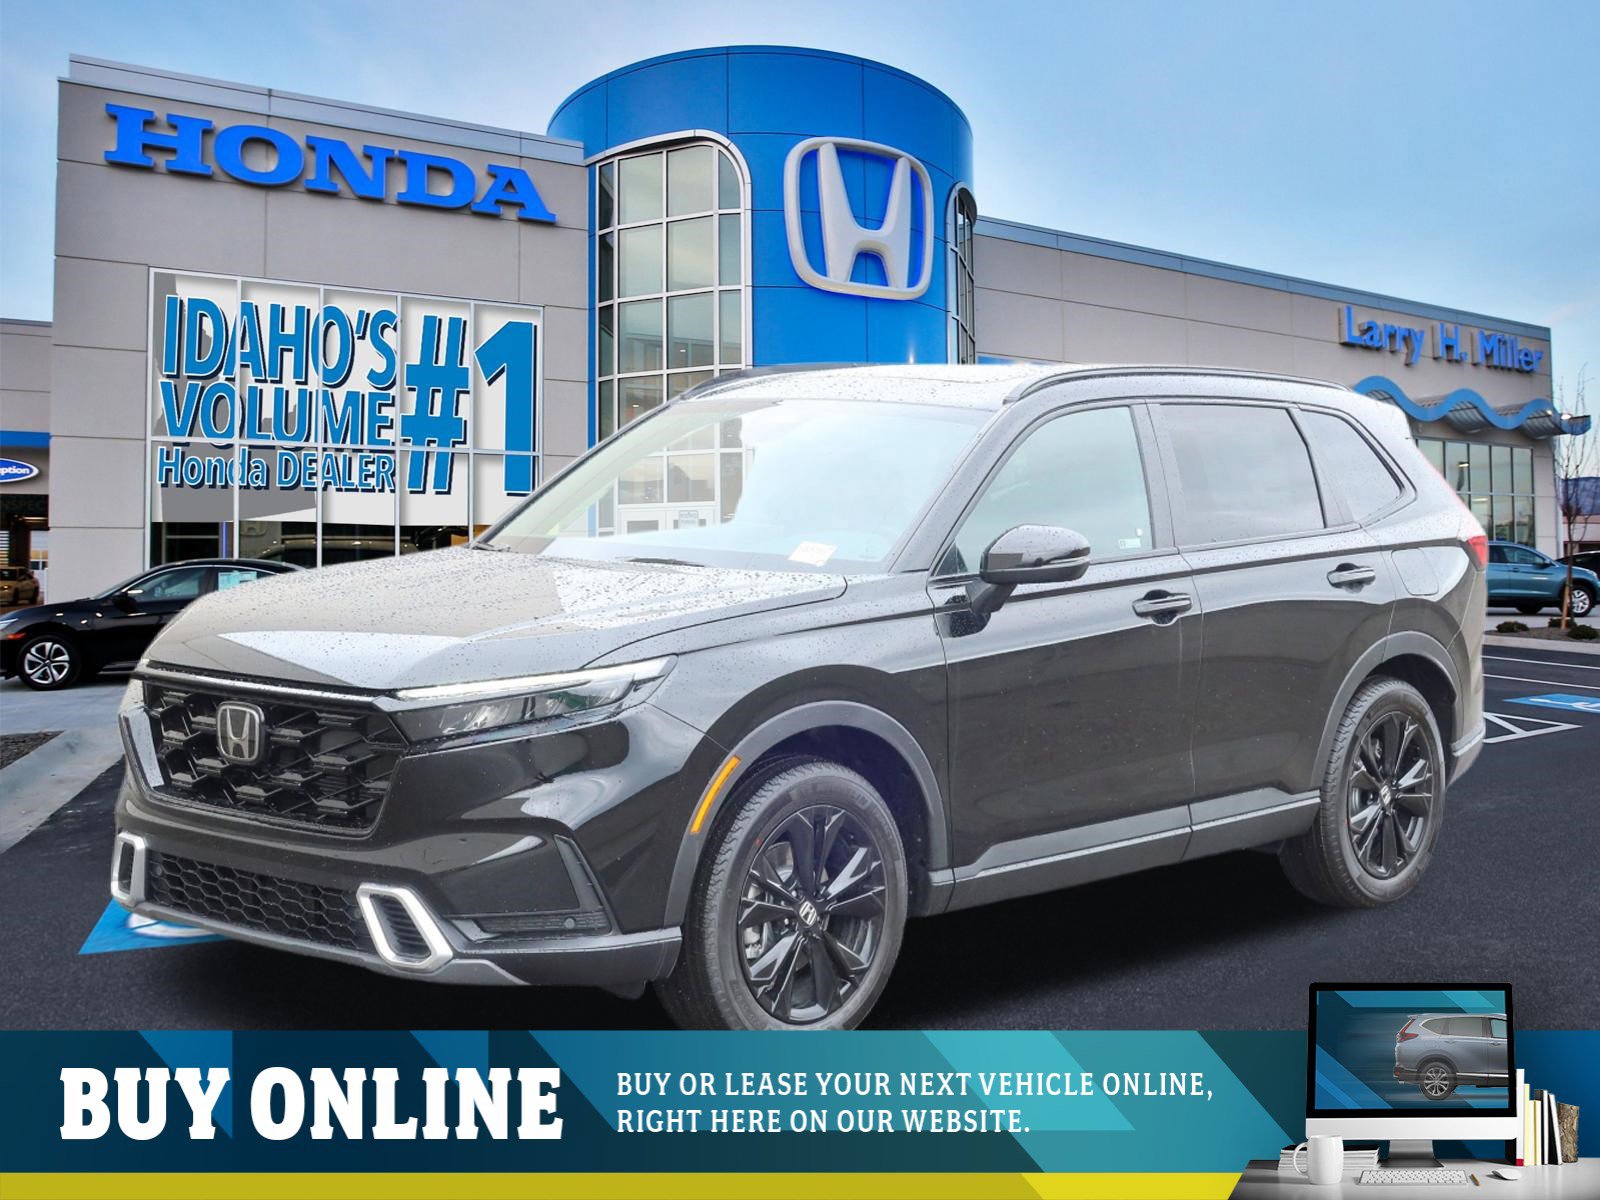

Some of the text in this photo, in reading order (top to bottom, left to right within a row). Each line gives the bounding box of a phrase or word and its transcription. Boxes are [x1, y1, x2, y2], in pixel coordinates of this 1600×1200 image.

[104, 103, 558, 223] HONDA
[162, 294, 398, 390] IDAHO'S
[1343, 305, 1545, 373] Larry H. Miller
[159, 380, 397, 453] VOLUME
[0, 465, 30, 476] ption
[156, 446, 397, 493] Honda DEALER
